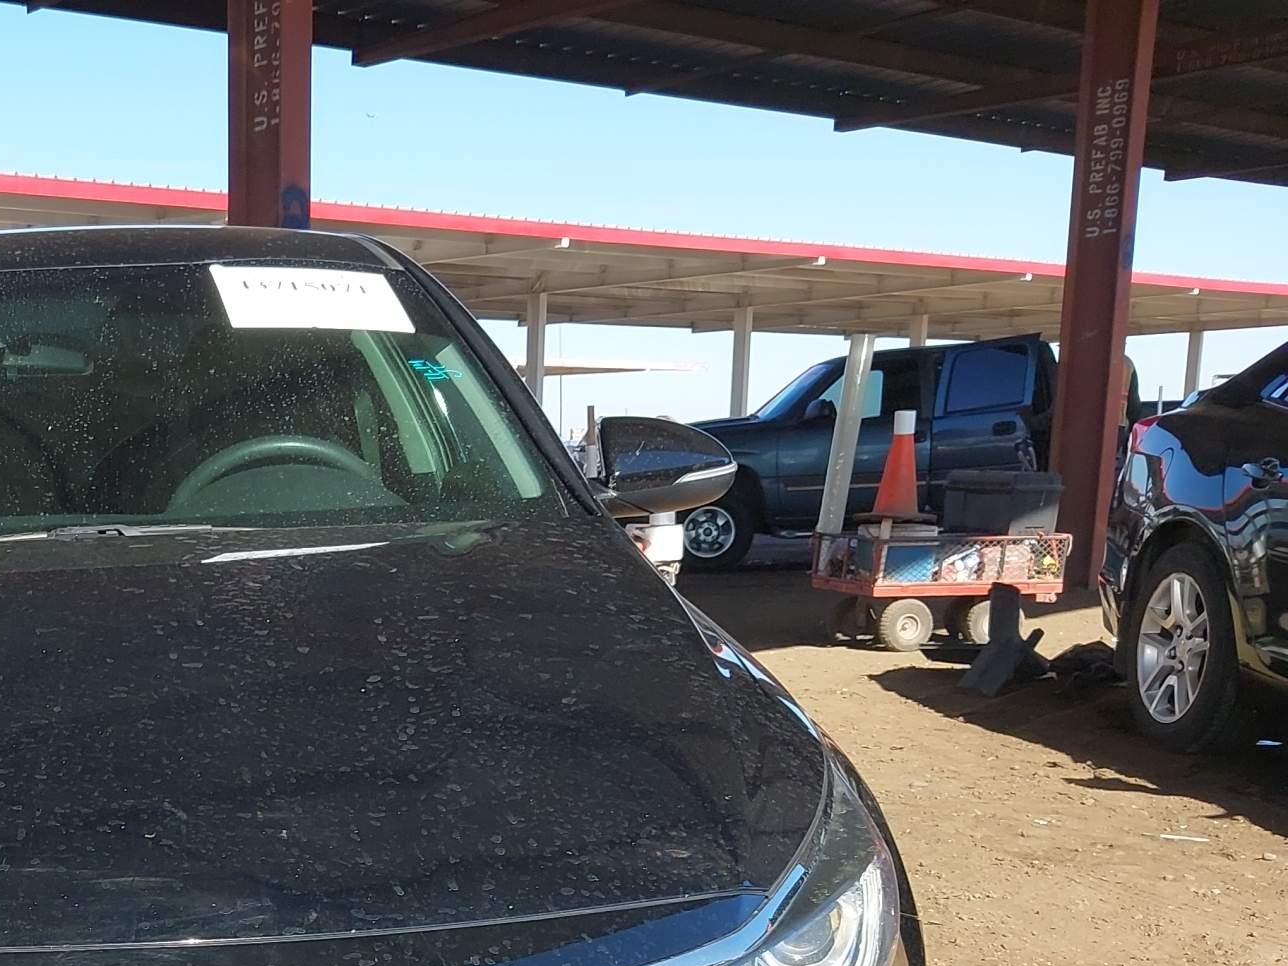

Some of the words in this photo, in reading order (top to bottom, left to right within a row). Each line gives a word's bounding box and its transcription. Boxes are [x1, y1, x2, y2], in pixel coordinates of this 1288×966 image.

[253, 81, 268, 132] U.S.
[1088, 123, 1110, 193] PREFAB
[1085, 202, 1103, 238] U.S.
